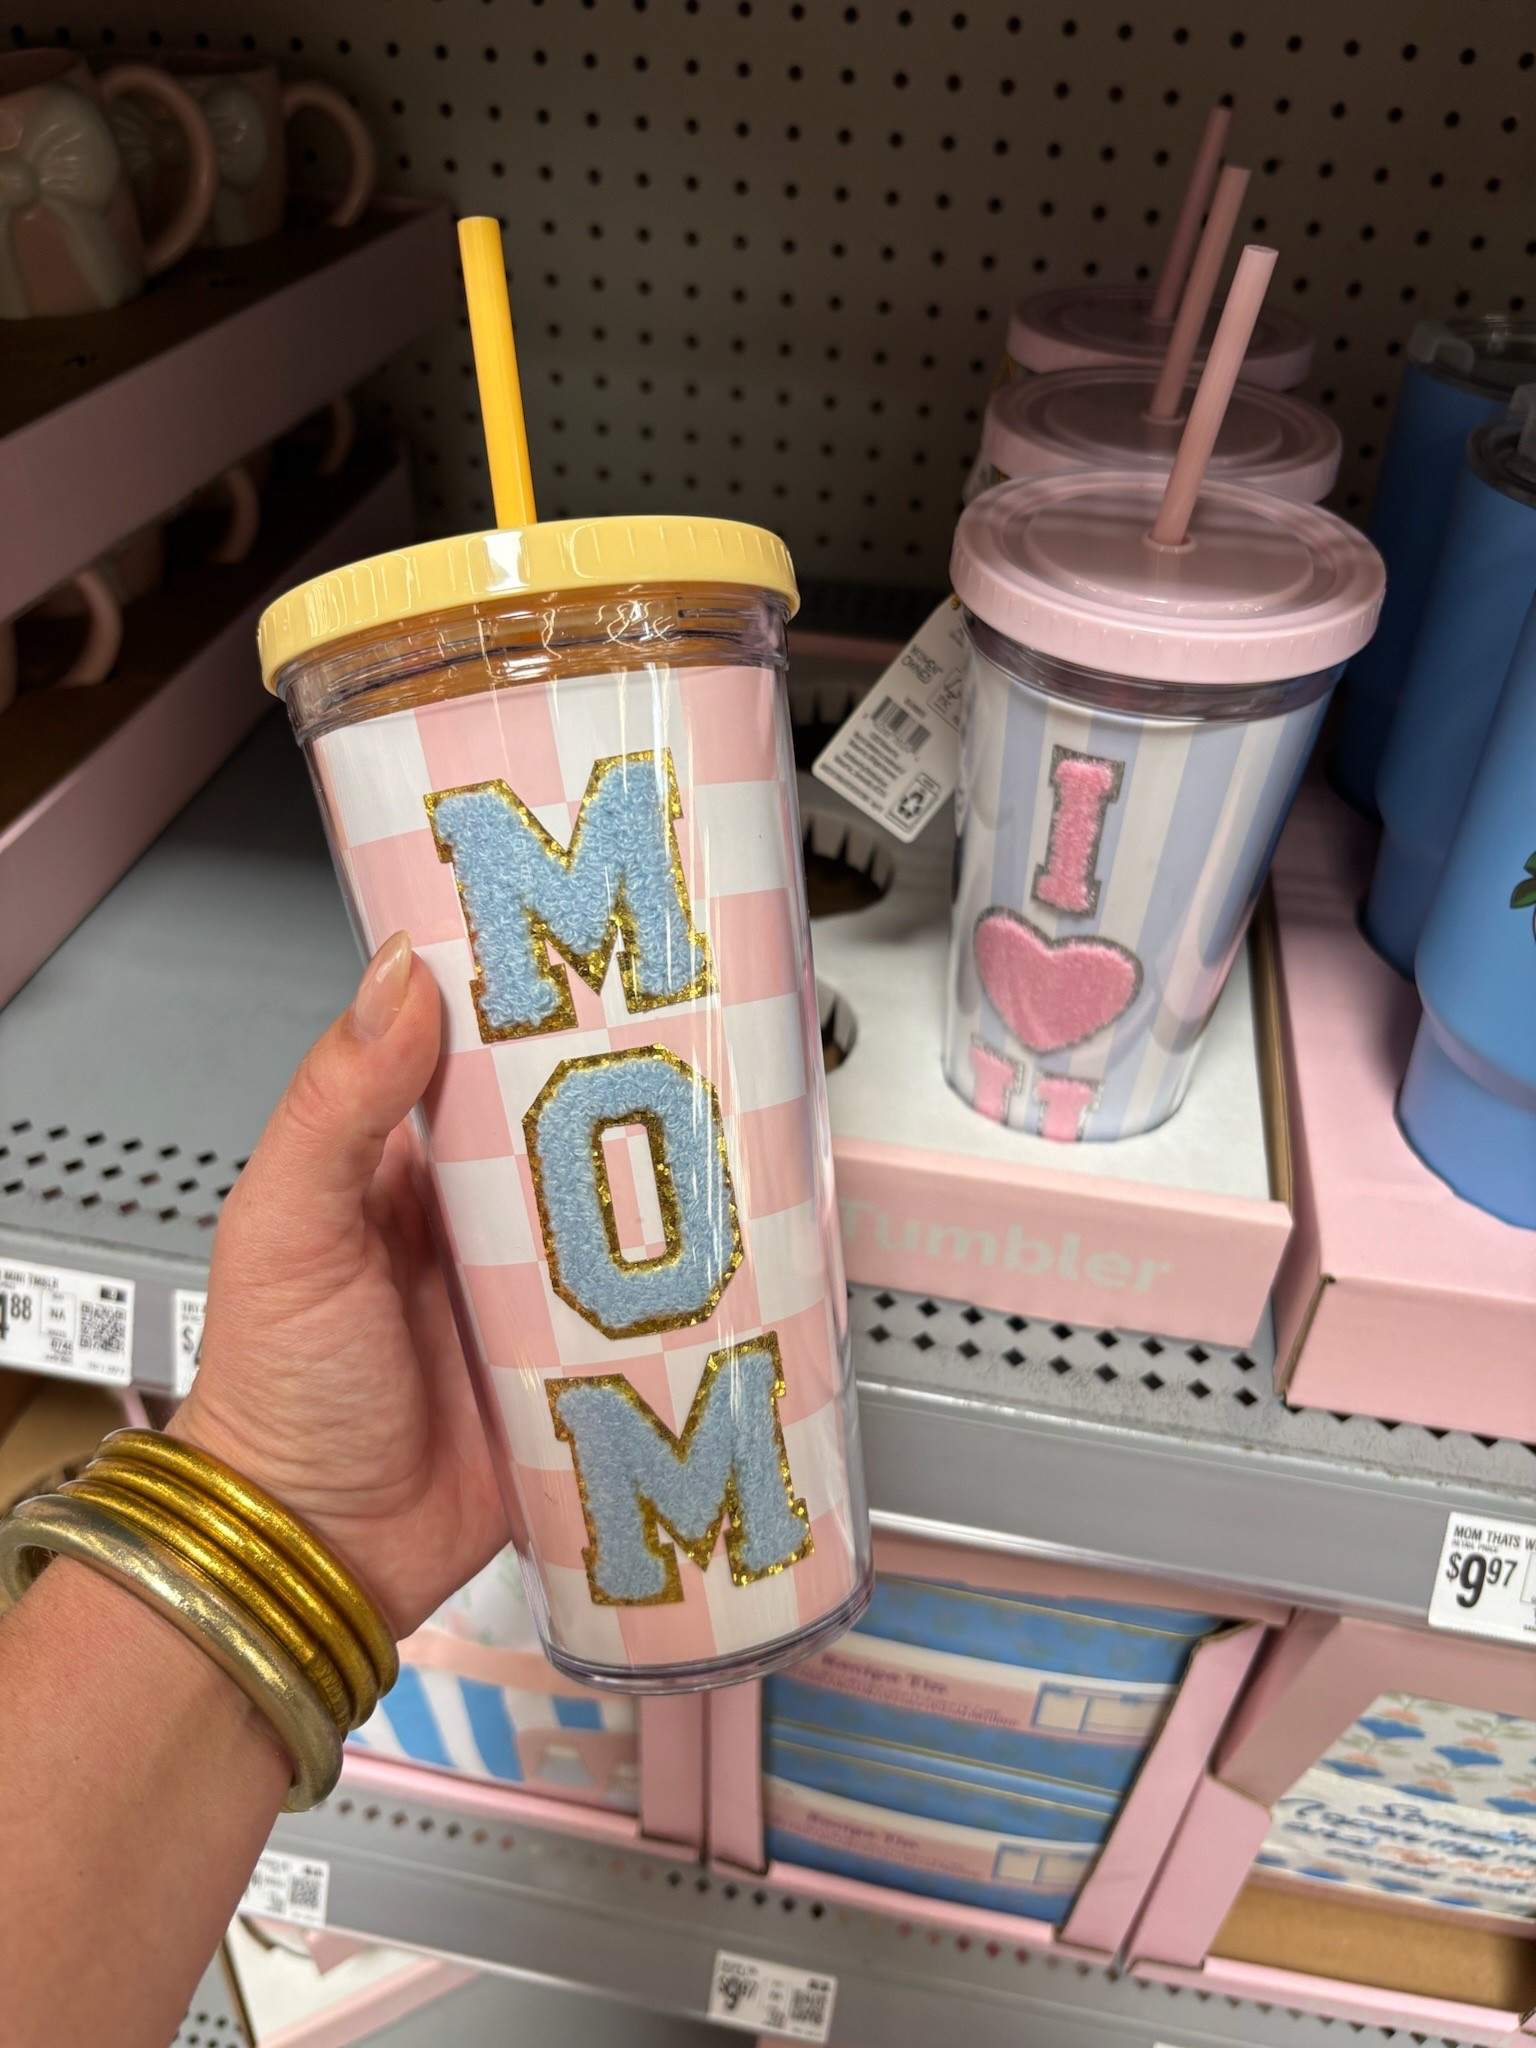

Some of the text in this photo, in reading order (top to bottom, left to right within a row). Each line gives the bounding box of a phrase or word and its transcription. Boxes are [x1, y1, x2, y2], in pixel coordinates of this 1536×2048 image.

[838, 1198, 1174, 1294] Tumbler
[1454, 1525, 1482, 1540] MOM
[1487, 1530, 1521, 1548] THATS
